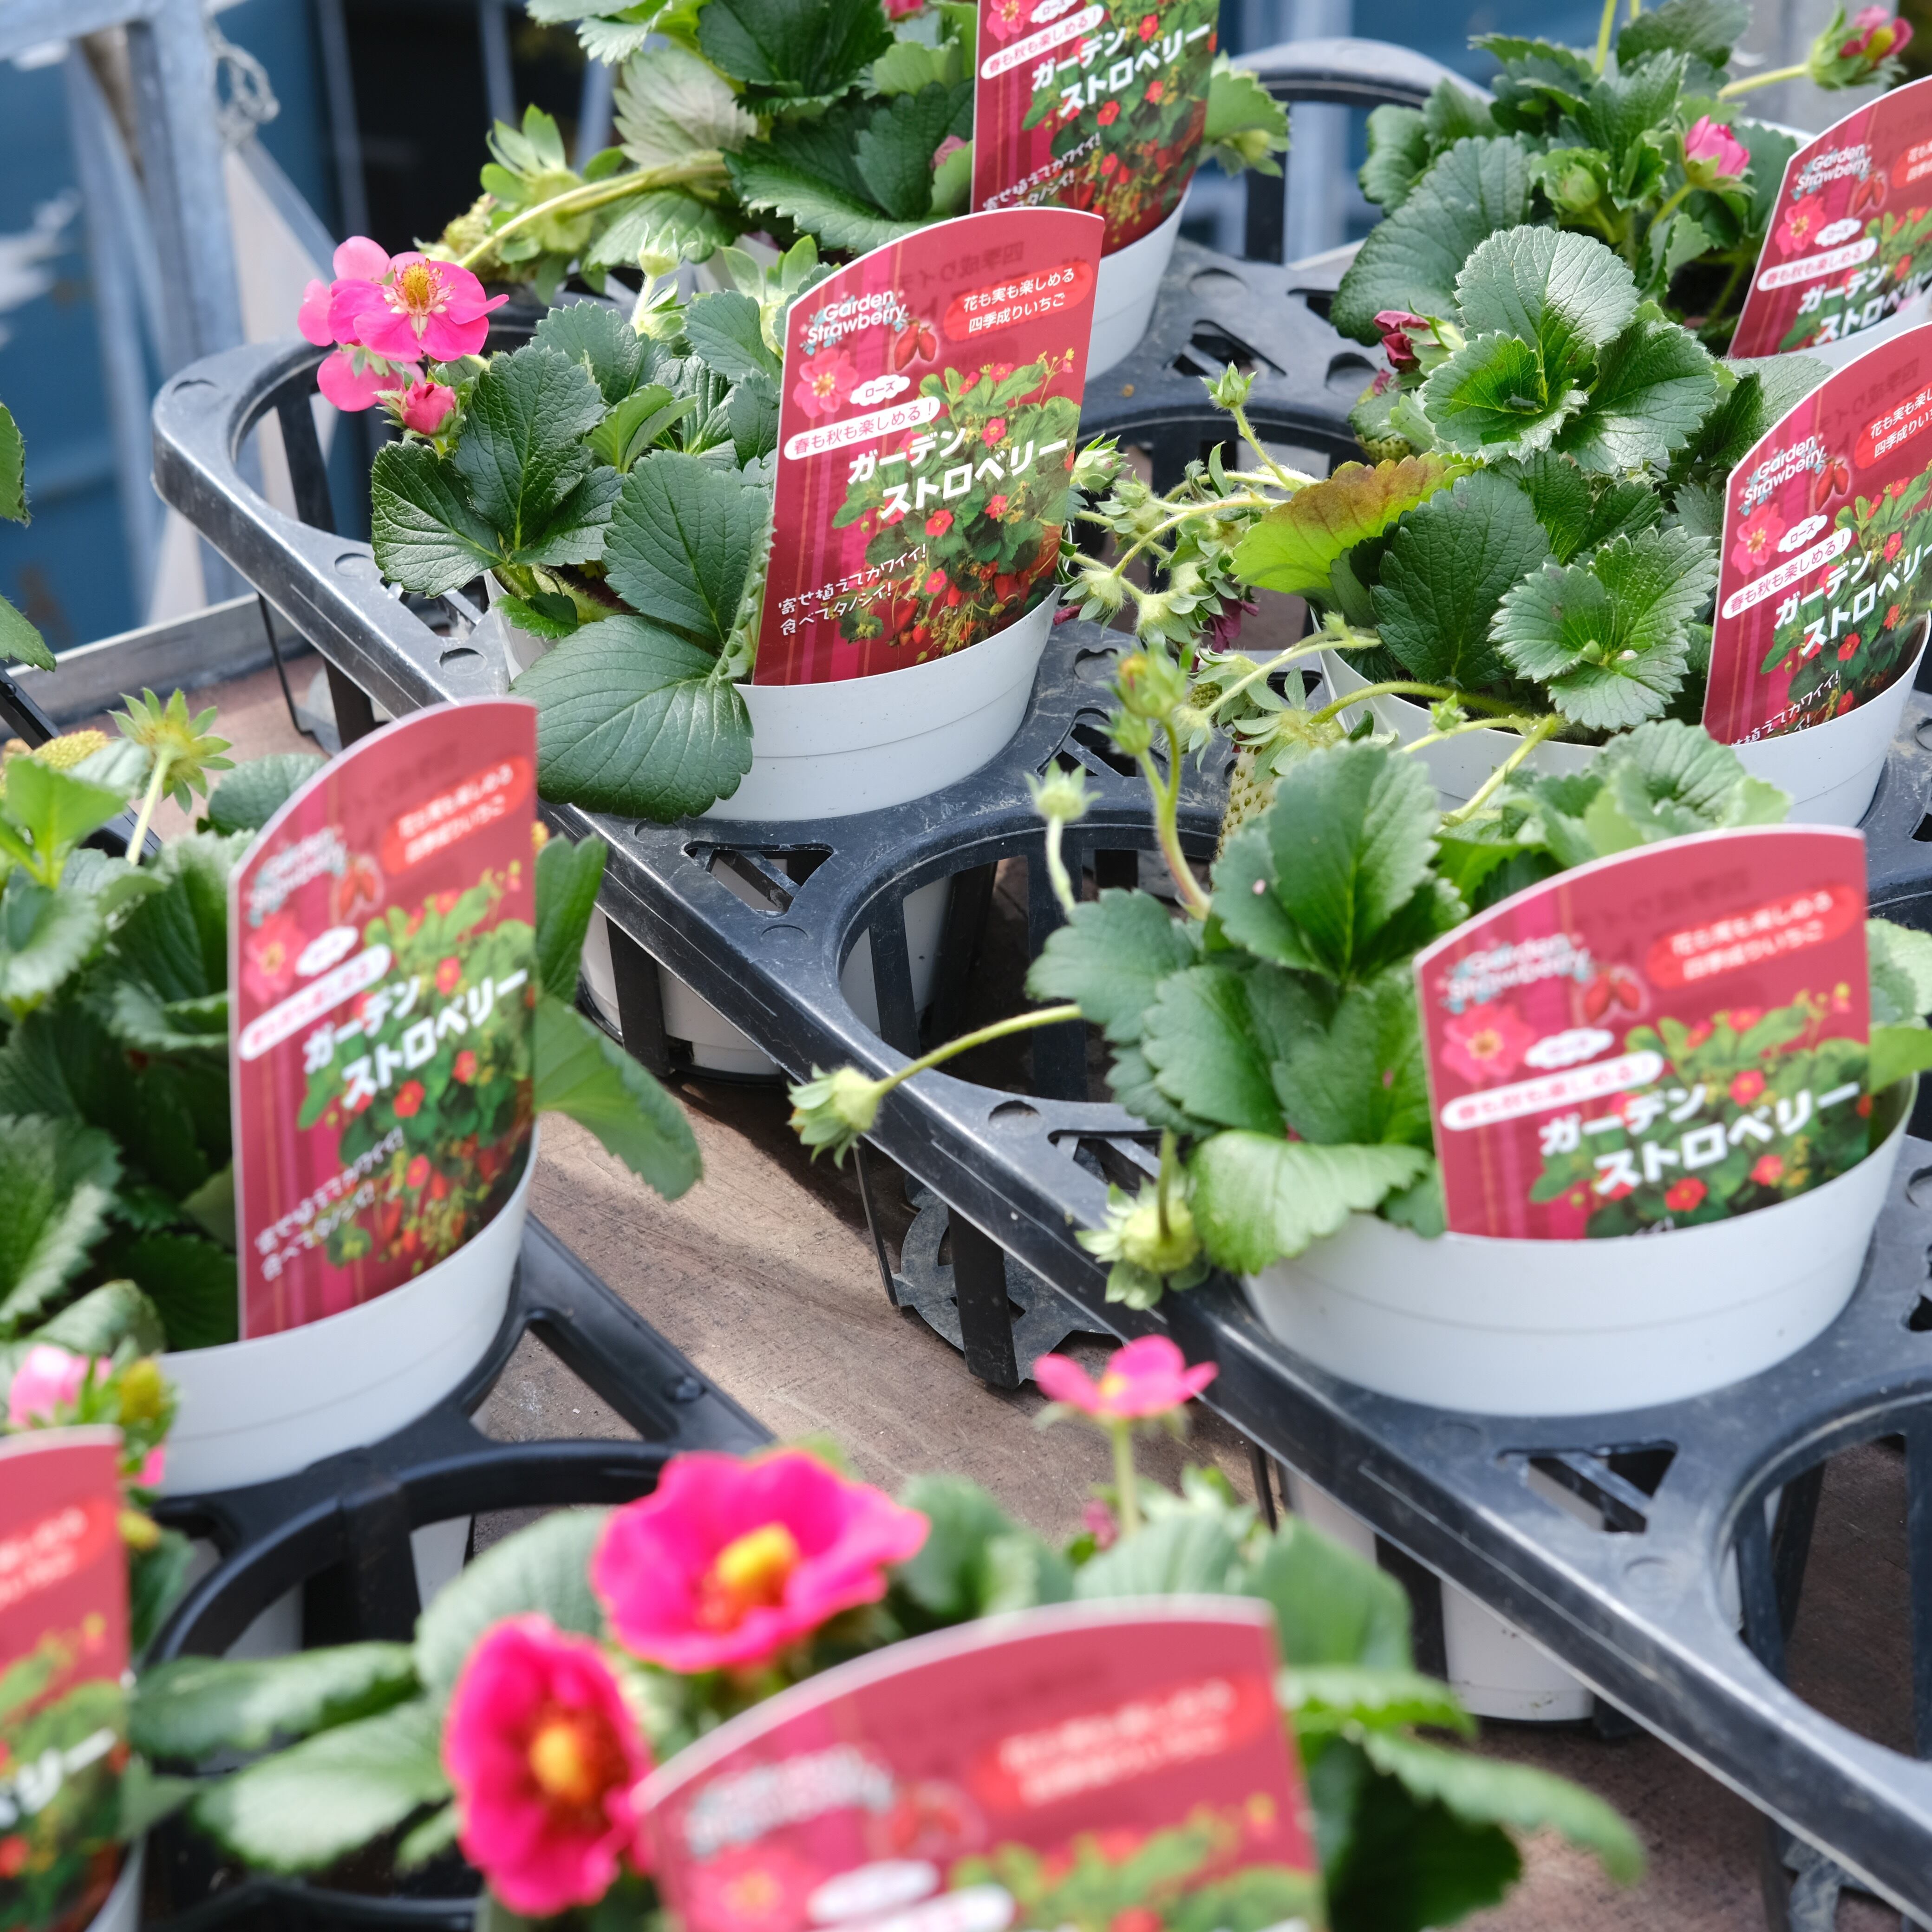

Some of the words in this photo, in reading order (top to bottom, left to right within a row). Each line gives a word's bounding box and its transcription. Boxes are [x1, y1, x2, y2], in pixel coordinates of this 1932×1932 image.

[1031, 27, 1126, 91] ガーデン
[1059, 24, 1210, 117] ストロベリー
[823, 290, 894, 321] Garden
[964, 268, 1074, 313] 花も実も楽しめる
[968, 293, 1065, 333] 四季成りいちご
[1797, 264, 1889, 315] ガーデン
[808, 303, 907, 344] Strawberry
[865, 382, 894, 398] ローズ
[794, 402, 932, 453] 春も秋も楽しめる！
[848, 427, 966, 484] ガーデン
[880, 439, 1067, 519] ストロベリー
[1745, 445, 1825, 505] Strawberry
[1758, 435, 1815, 479] Garden
[1791, 523, 1815, 543] ローズ
[1730, 534, 1845, 612] 春も秋も楽しめる！
[1774, 550, 1872, 630] ガーデン
[303, 975, 420, 1074] ガーデン
[342, 968, 528, 1110] ストロベリー
[1539, 1083, 1705, 1156] ガーデン
[1593, 1081, 1859, 1195] ストロベリー
